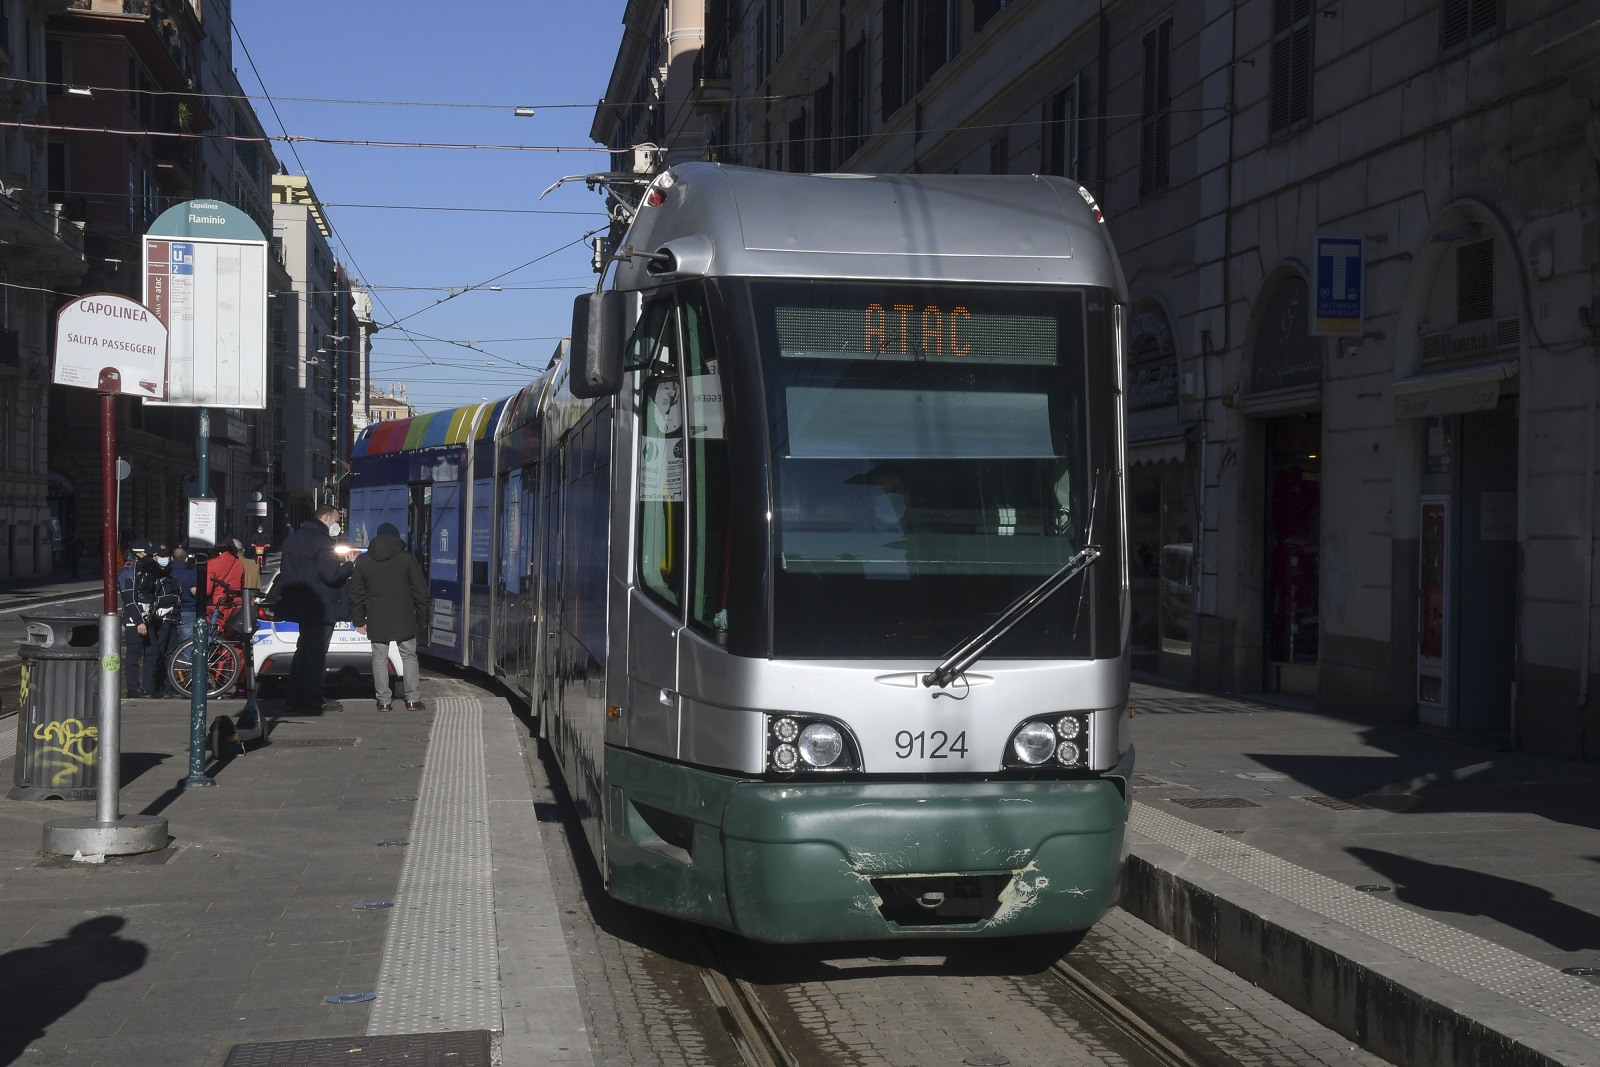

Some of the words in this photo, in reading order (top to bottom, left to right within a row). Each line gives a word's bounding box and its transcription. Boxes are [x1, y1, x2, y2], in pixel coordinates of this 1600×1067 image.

[190, 201, 219, 211] Capolinea
[189, 214, 226, 225] Flaminio
[173, 264, 179, 274] 2
[1320, 243, 1360, 300] T
[81, 300, 148, 322] CAPOLINEA
[865, 303, 971, 356] ATAC
[68, 333, 99, 346] SALITA
[102, 338, 156, 355] PASSEGGERI
[895, 730, 969, 759] 9124
